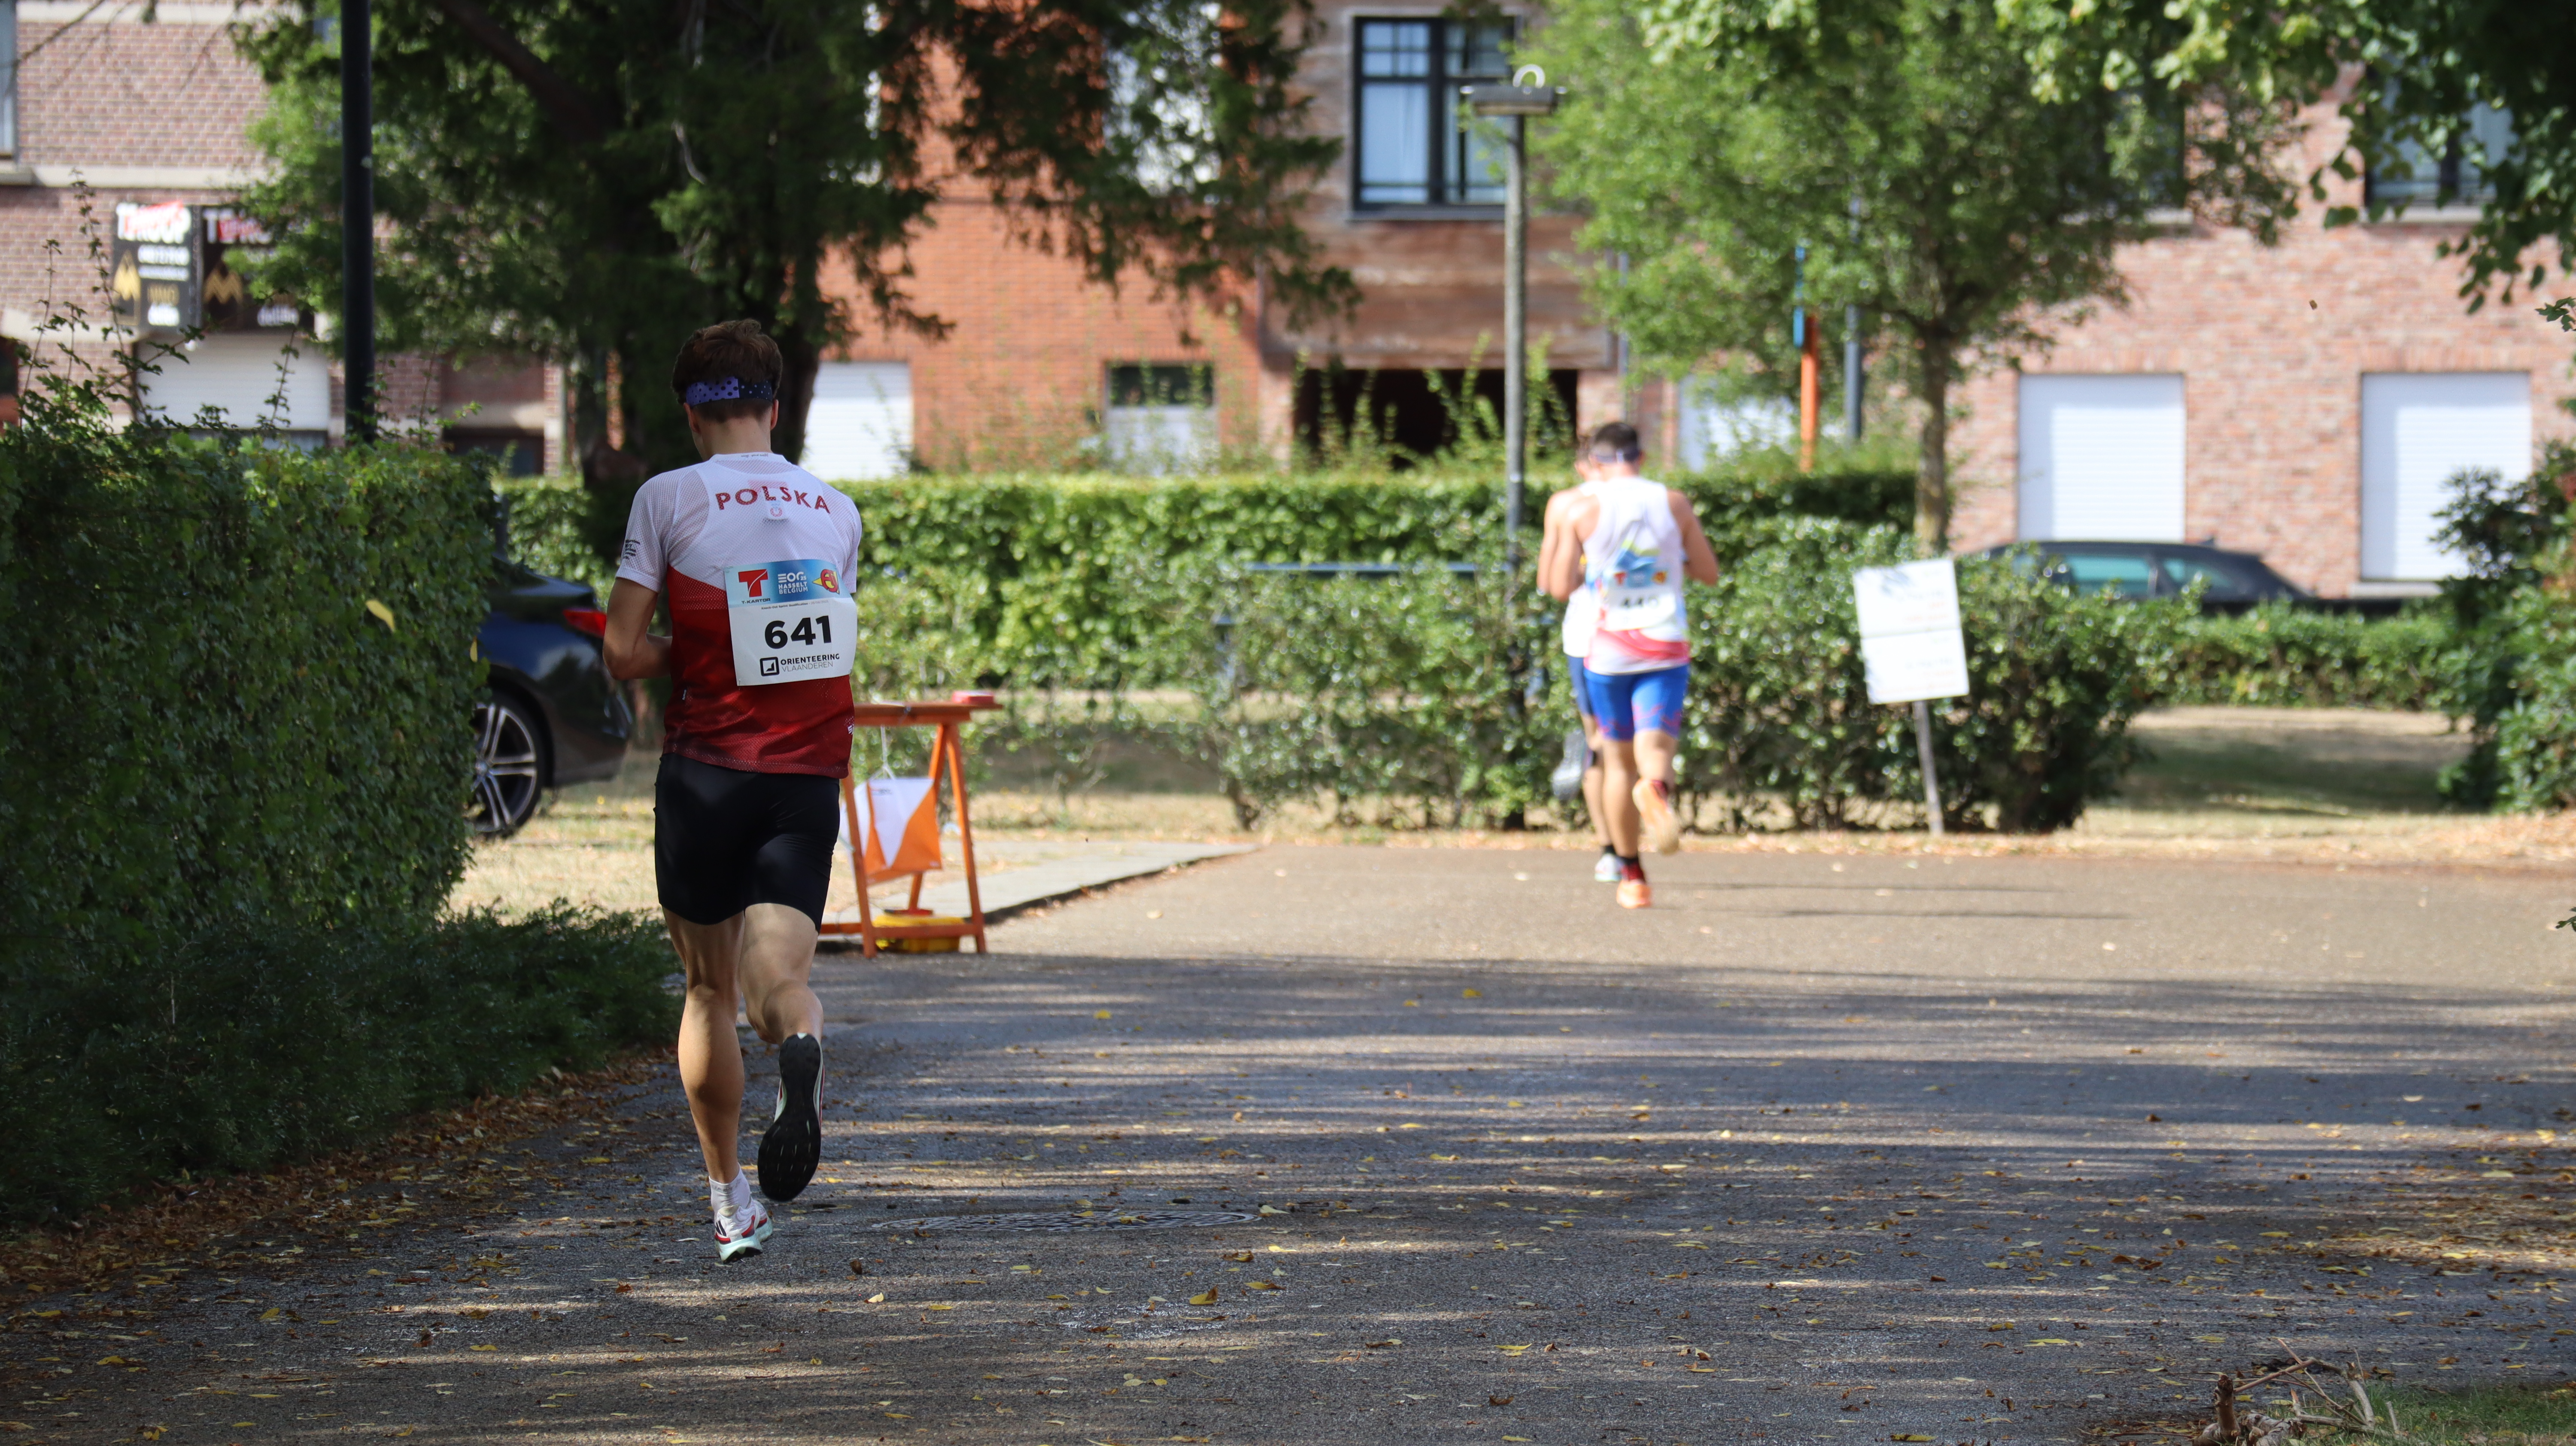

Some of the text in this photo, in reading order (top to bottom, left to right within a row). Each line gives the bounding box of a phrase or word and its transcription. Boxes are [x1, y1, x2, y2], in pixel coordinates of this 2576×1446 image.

[715, 486, 831, 514] POLSKA
[778, 581, 808, 590] HASSELT
[778, 586, 808, 595] BELGIUM
[764, 615, 831, 649] 641
[780, 653, 840, 665] ORIENTEERING
[781, 661, 833, 672] VLAANDEREN
